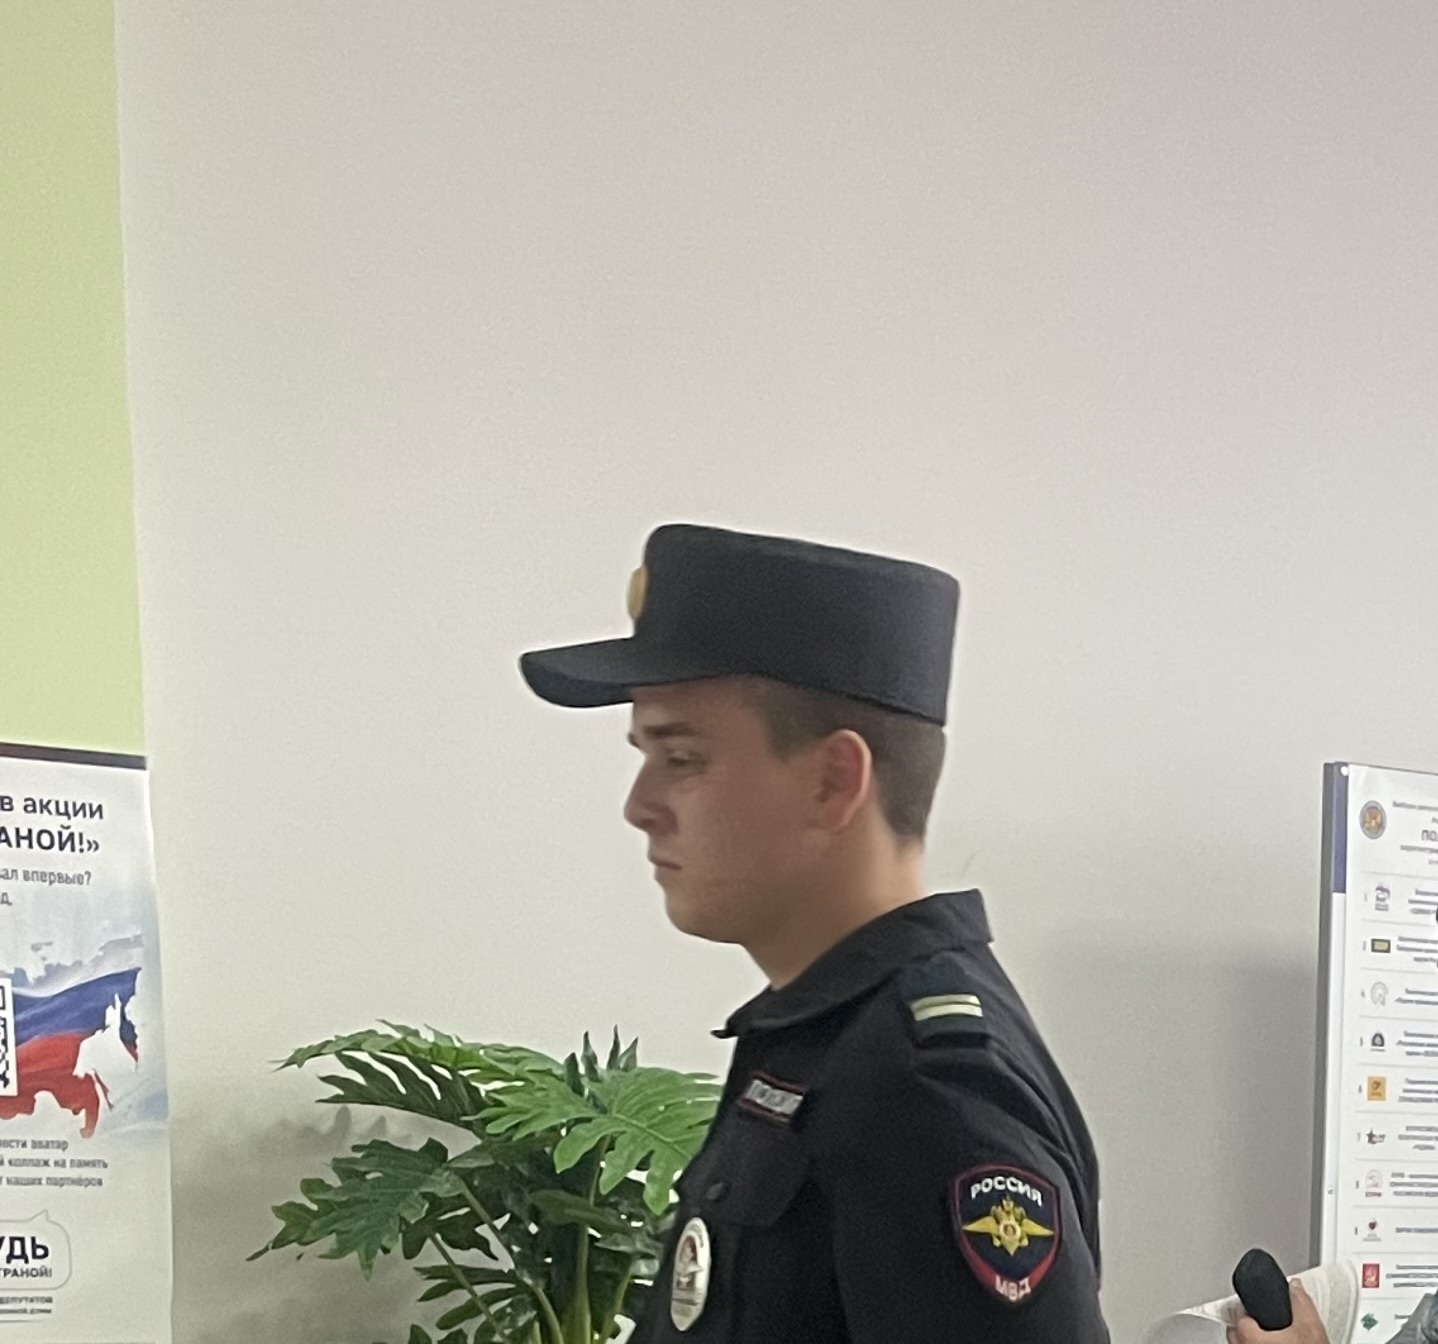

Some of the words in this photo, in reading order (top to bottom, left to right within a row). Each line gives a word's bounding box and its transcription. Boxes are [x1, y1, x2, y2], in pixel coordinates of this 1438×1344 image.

[23, 797, 104, 821] акции
[970, 1176, 1042, 1207] РОССИЯ
[995, 1274, 1031, 1302] МВД
